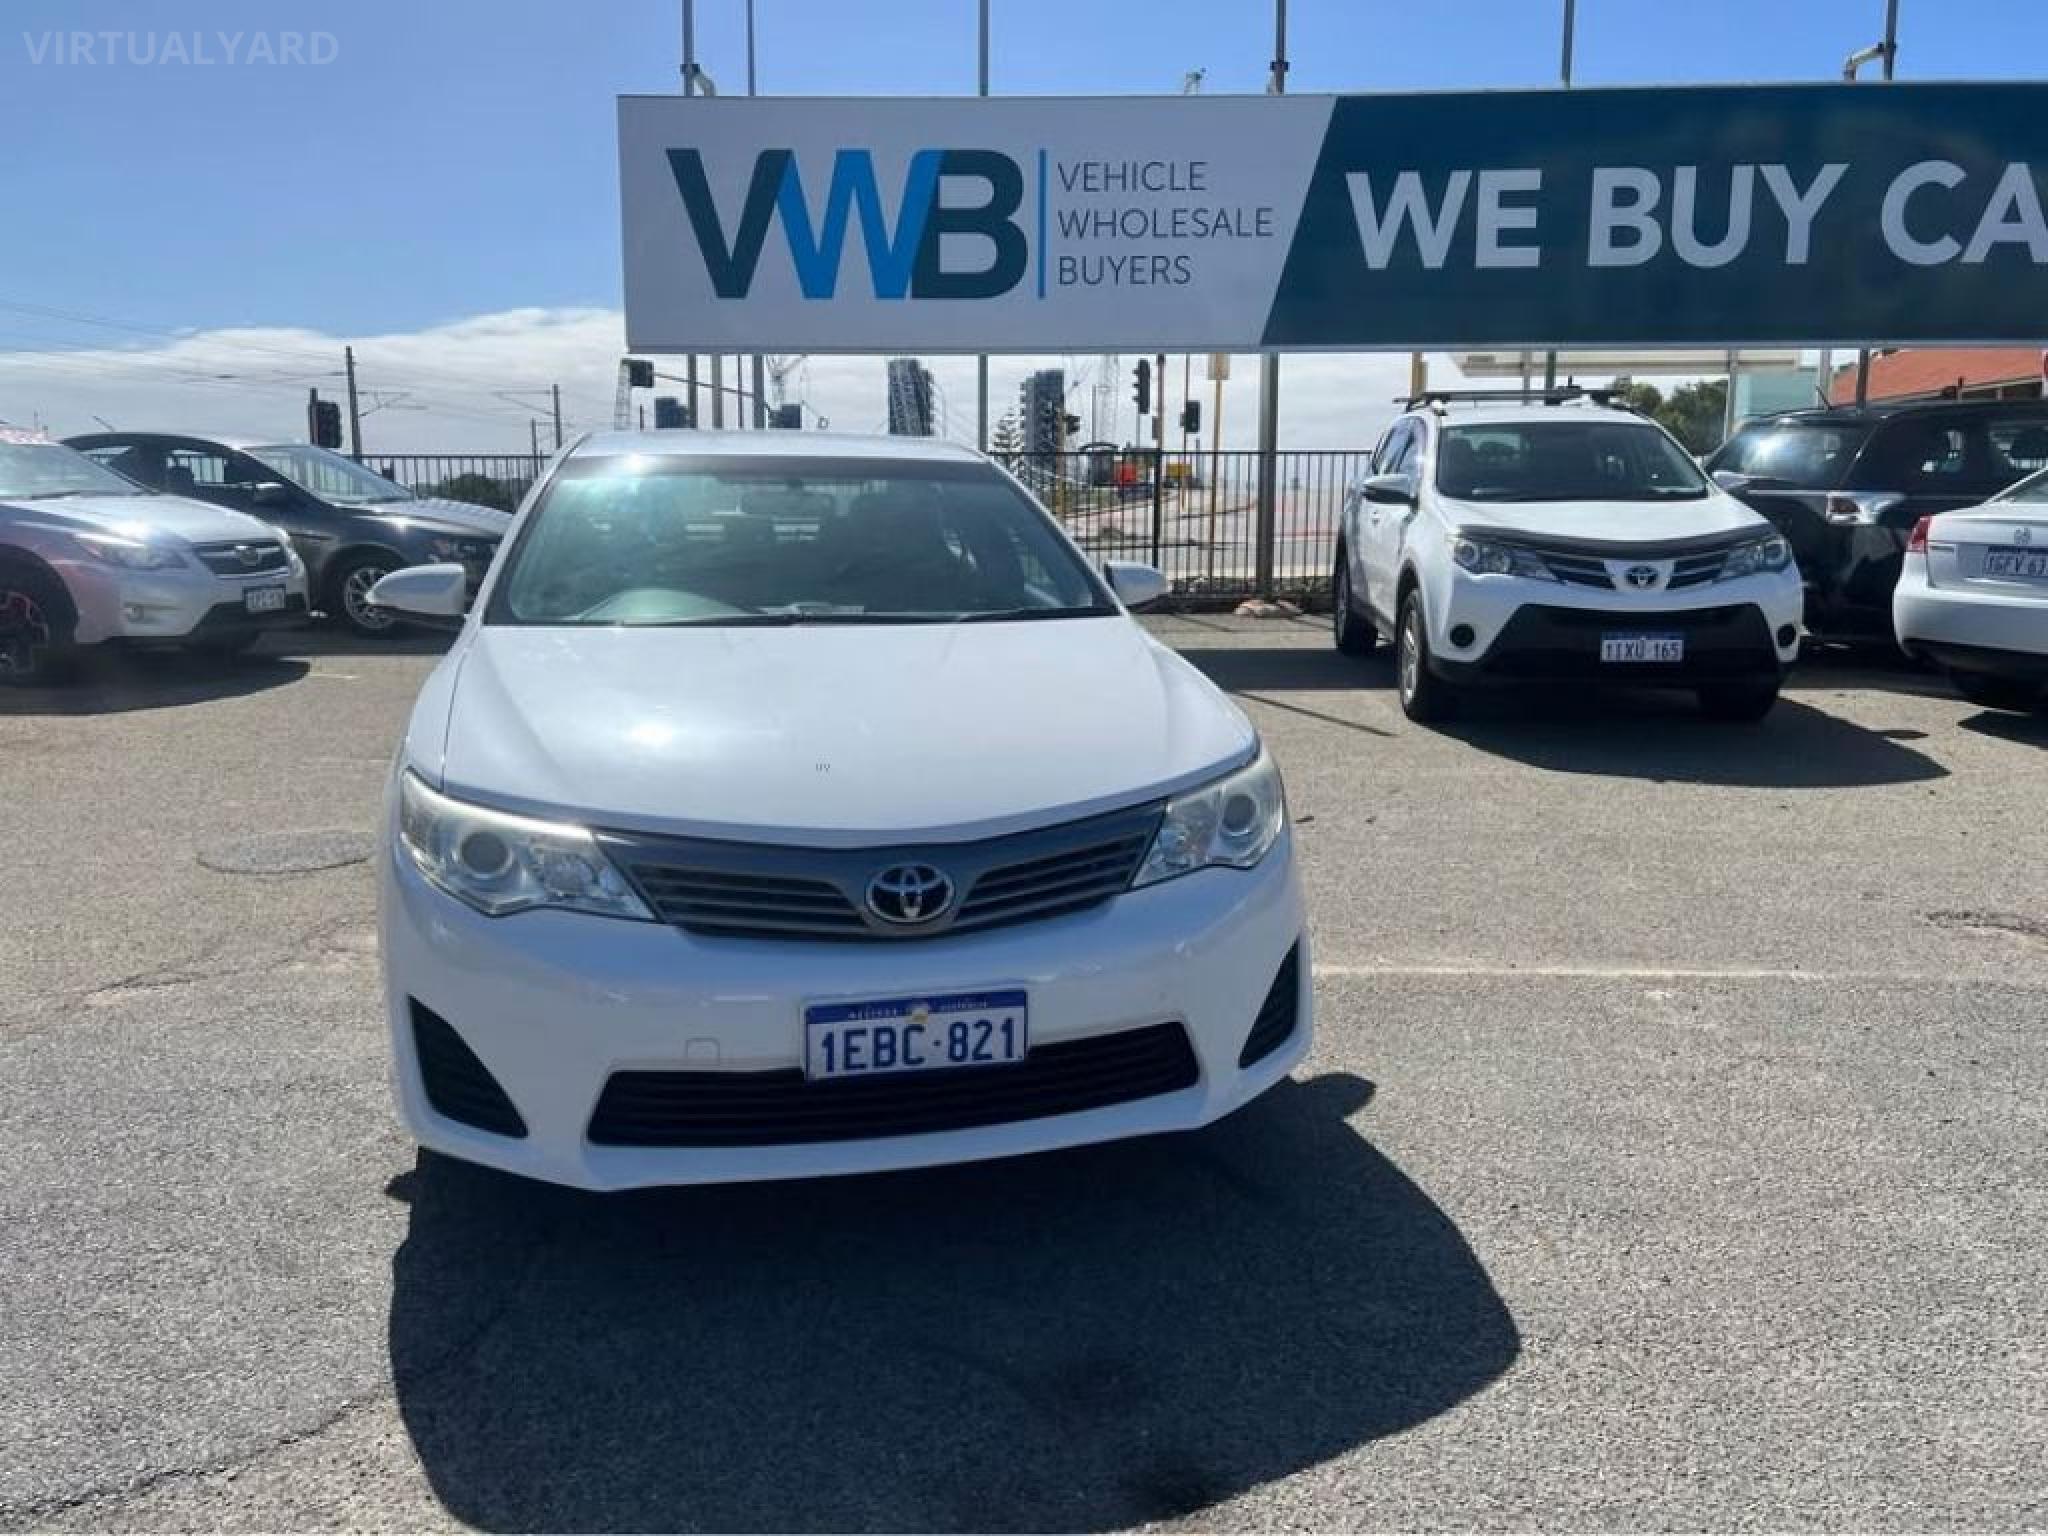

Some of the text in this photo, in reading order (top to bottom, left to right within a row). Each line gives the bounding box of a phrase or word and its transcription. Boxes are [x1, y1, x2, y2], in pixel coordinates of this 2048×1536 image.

[1057, 161, 1206, 192] VEHICLE
[665, 148, 1028, 300] VWB
[1057, 207, 1273, 239] WHOLESALE
[1346, 169, 1542, 270] WE
[1588, 162, 1851, 270] BUY
[1057, 255, 1192, 286] BUYERS
